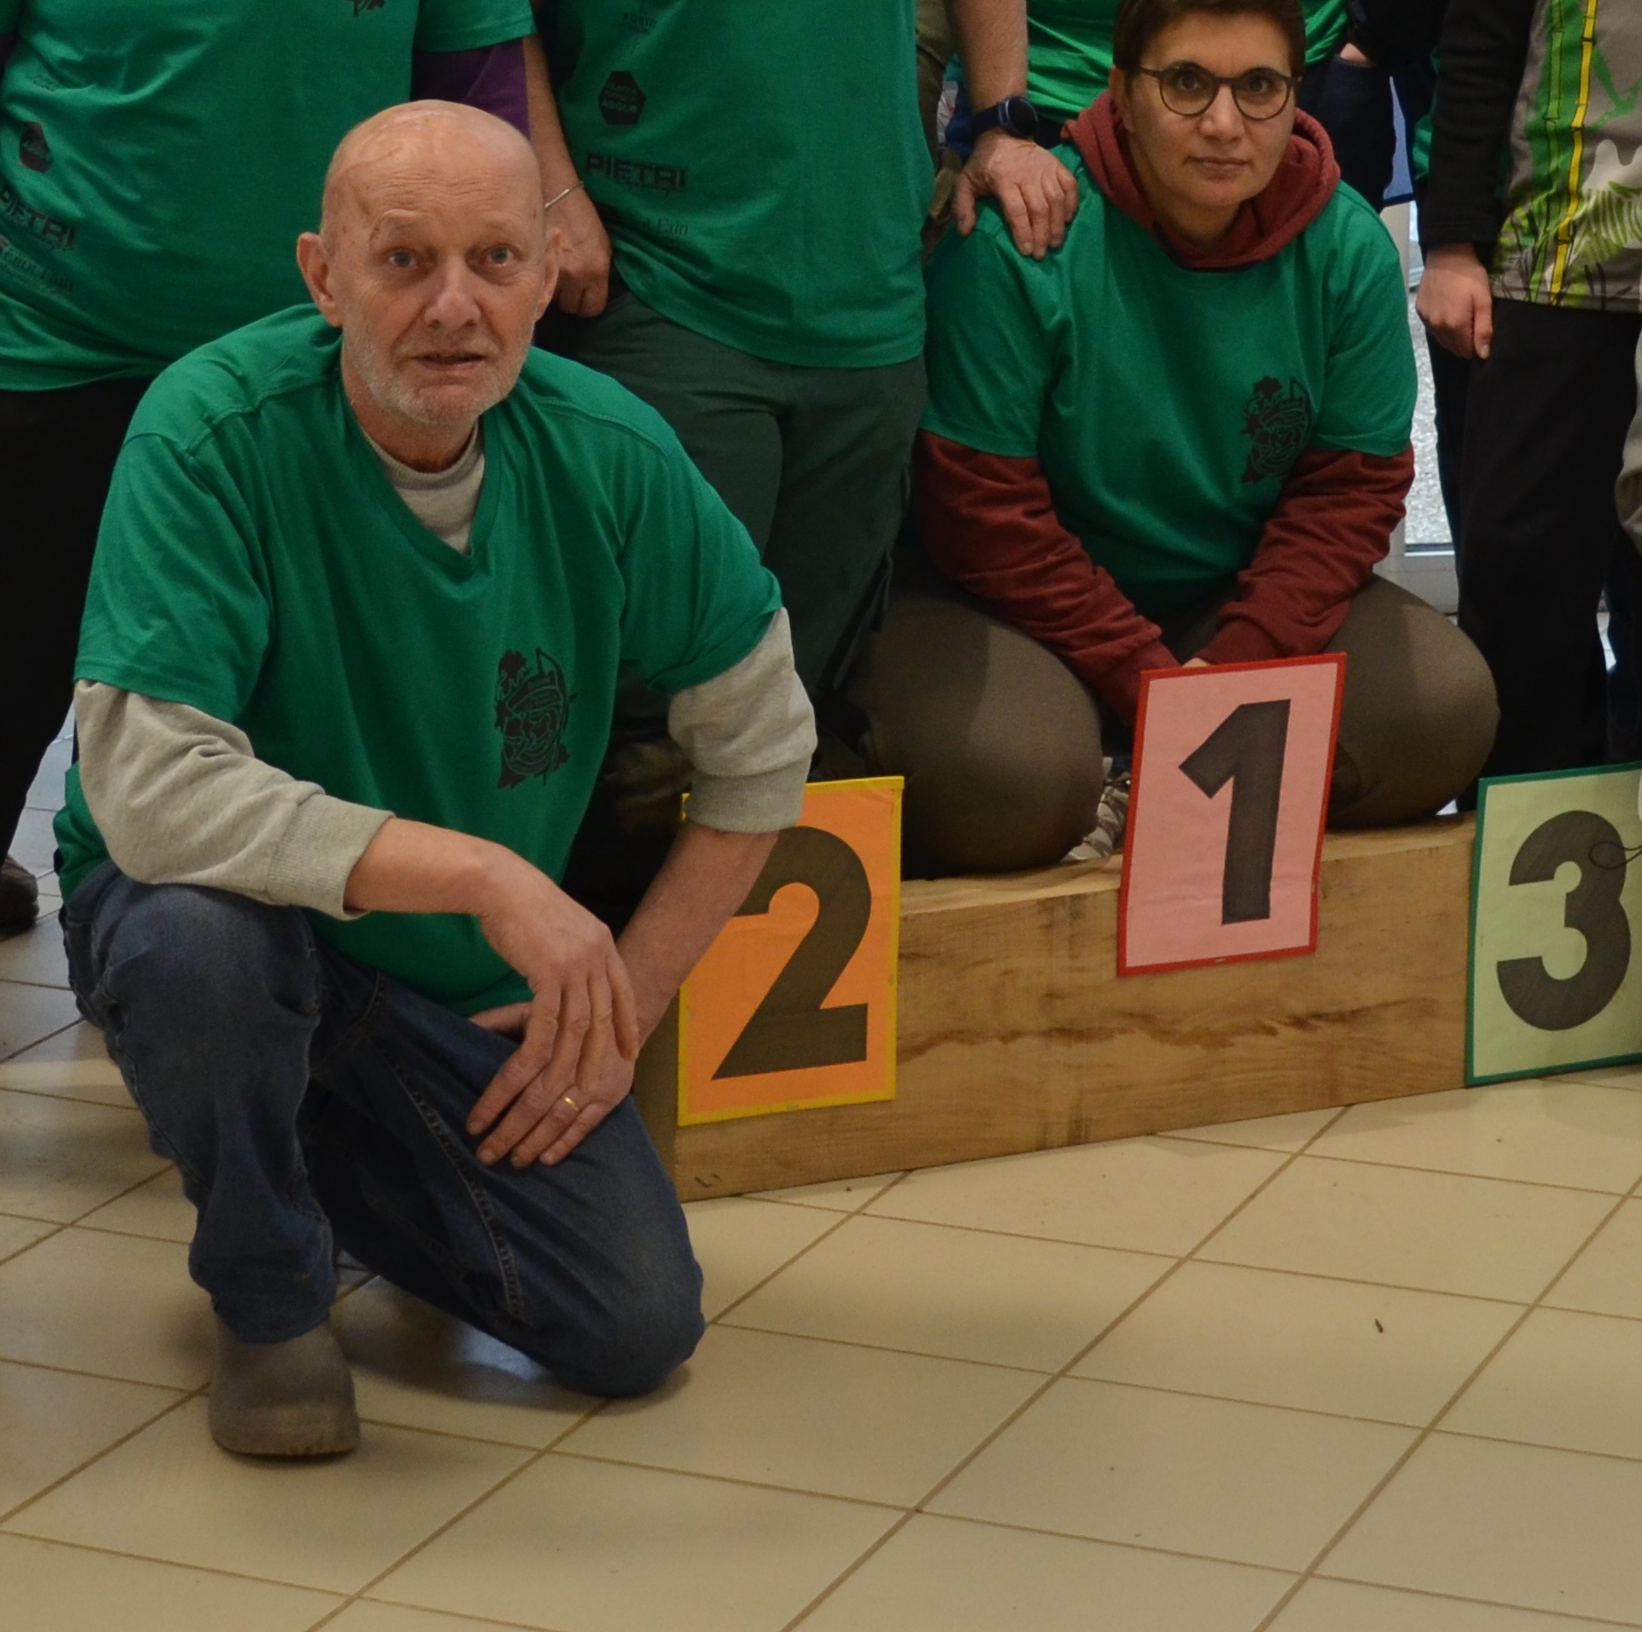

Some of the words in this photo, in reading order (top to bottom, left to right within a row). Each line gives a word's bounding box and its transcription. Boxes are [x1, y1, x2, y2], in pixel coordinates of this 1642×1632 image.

[1177, 698, 1292, 925] 1
[1495, 808, 1631, 1031] 3
[709, 824, 873, 1080] 2
